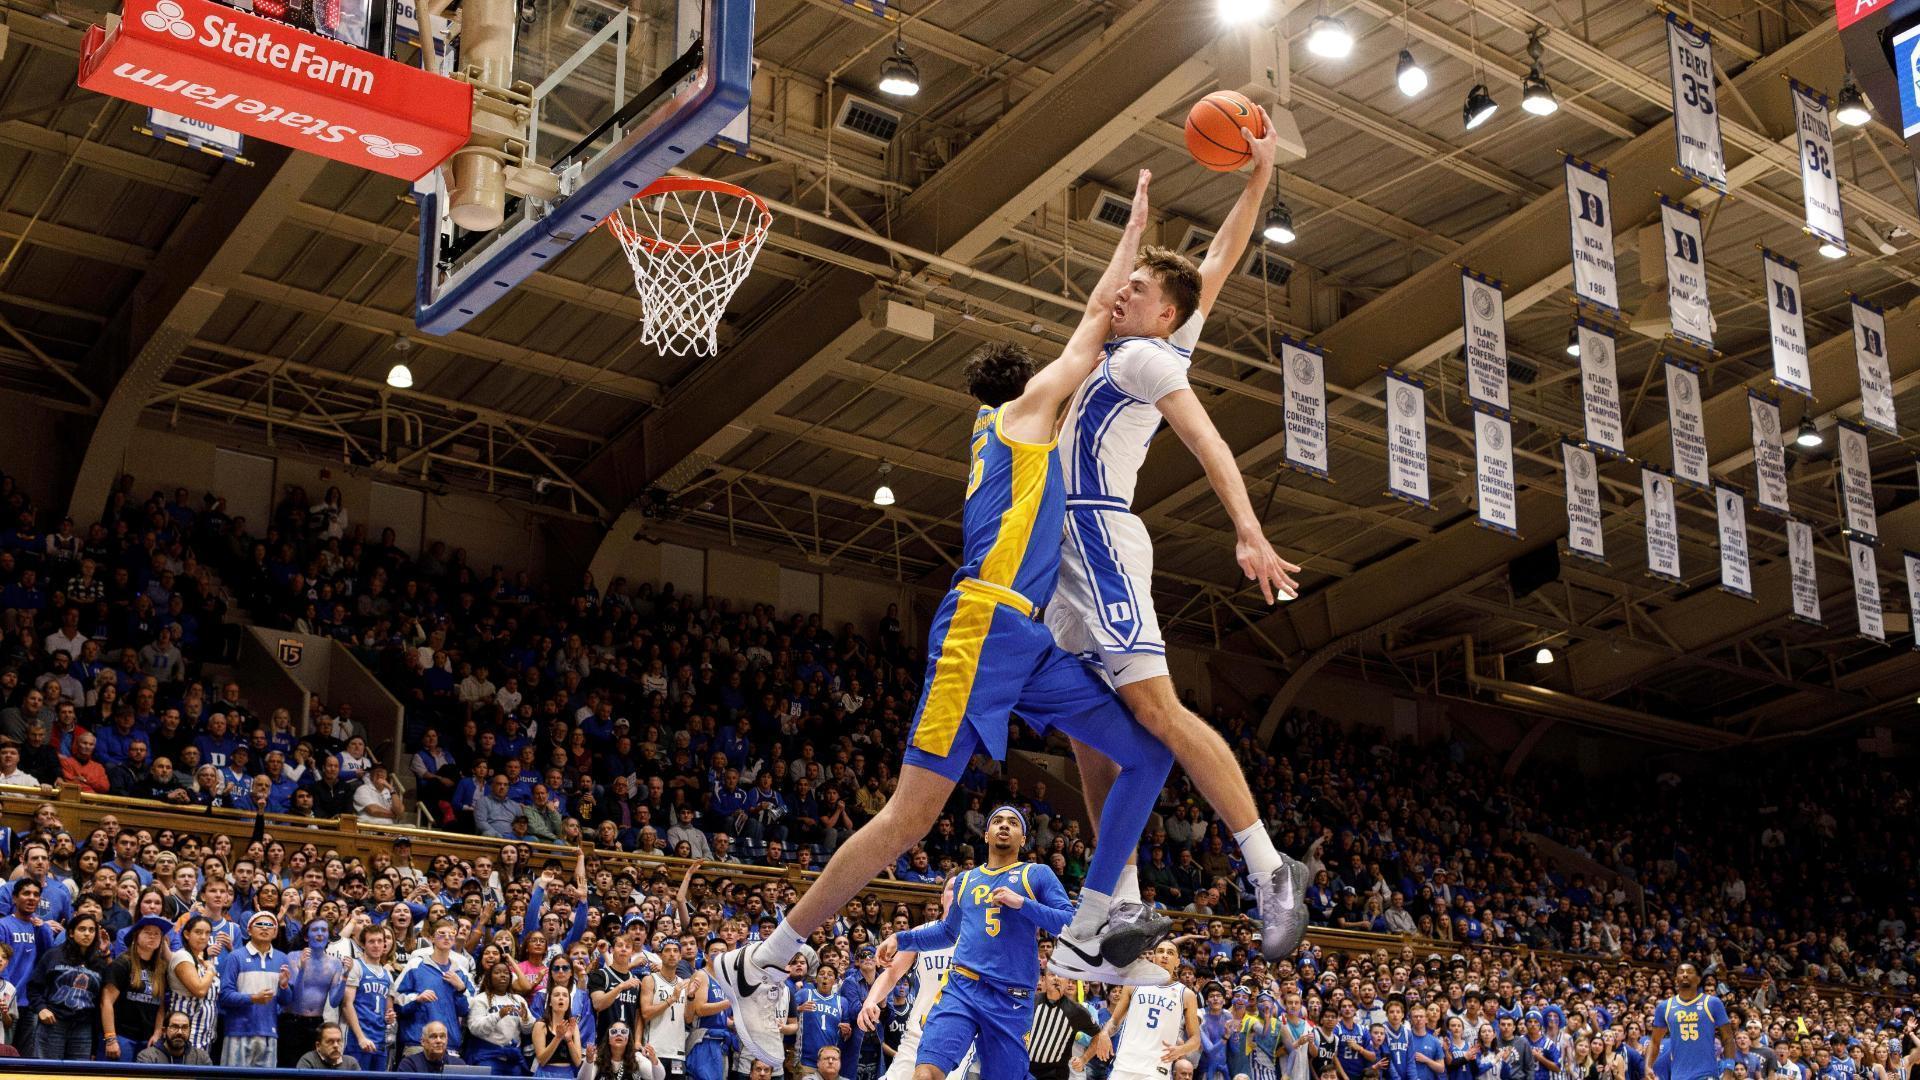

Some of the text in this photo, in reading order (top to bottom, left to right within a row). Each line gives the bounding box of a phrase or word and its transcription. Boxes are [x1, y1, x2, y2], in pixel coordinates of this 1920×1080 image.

[1682, 73, 1713, 115] 35
[1805, 139, 1832, 180] 32
[1584, 236, 1603, 251] NCAA
[1575, 250, 1595, 266] FINAL
[1679, 273, 1697, 289] NCAA
[1473, 325, 1499, 343] ATLANTIC
[1781, 324, 1797, 337] NCAA
[1477, 338, 1495, 352] COAST
[1774, 335, 1790, 350] FINAL
[1469, 345, 1506, 367] CONFERENCE
[1471, 358, 1505, 378] CHAMPIONS
[1868, 366, 1881, 379] NCAA
[1588, 373, 1612, 389] ATLANTIC
[1291, 390, 1319, 407] ATLANTIC
[1482, 386, 1498, 399] 1964
[1593, 384, 1610, 398] COAST
[1296, 402, 1315, 416] COAST
[1286, 411, 1324, 430] CONFERENCE
[1394, 424, 1421, 439] ATLANTIC
[1400, 436, 1416, 447] COAST
[1390, 442, 1426, 461] CONFERENCE
[1392, 454, 1425, 471] CHAMPIONS
[1484, 455, 1507, 470] ATLANTIC
[1488, 466, 1504, 478] COAST
[1480, 474, 1513, 491] CONFERENCE
[1482, 485, 1512, 501] CHAMPIONS
[1106, 601, 1132, 622] D
[283, 646, 300, 662] 15
[985, 908, 1001, 938] 5
[13, 932, 35, 943] DUK
[374, 995, 380, 1014] 1
[1137, 993, 1177, 1012] DUKE
[620, 1004, 625, 1022] 1
[670, 1005, 675, 1022] 1
[776, 1007, 786, 1019] ke
[1146, 1007, 1161, 1029] 5
[1675, 1010, 1699, 1023] Pitt
[821, 1014, 826, 1031] 1
[889, 1020, 909, 1032] Du
[1680, 1023, 1699, 1041] 55
[1395, 1051, 1401, 1065] 1
